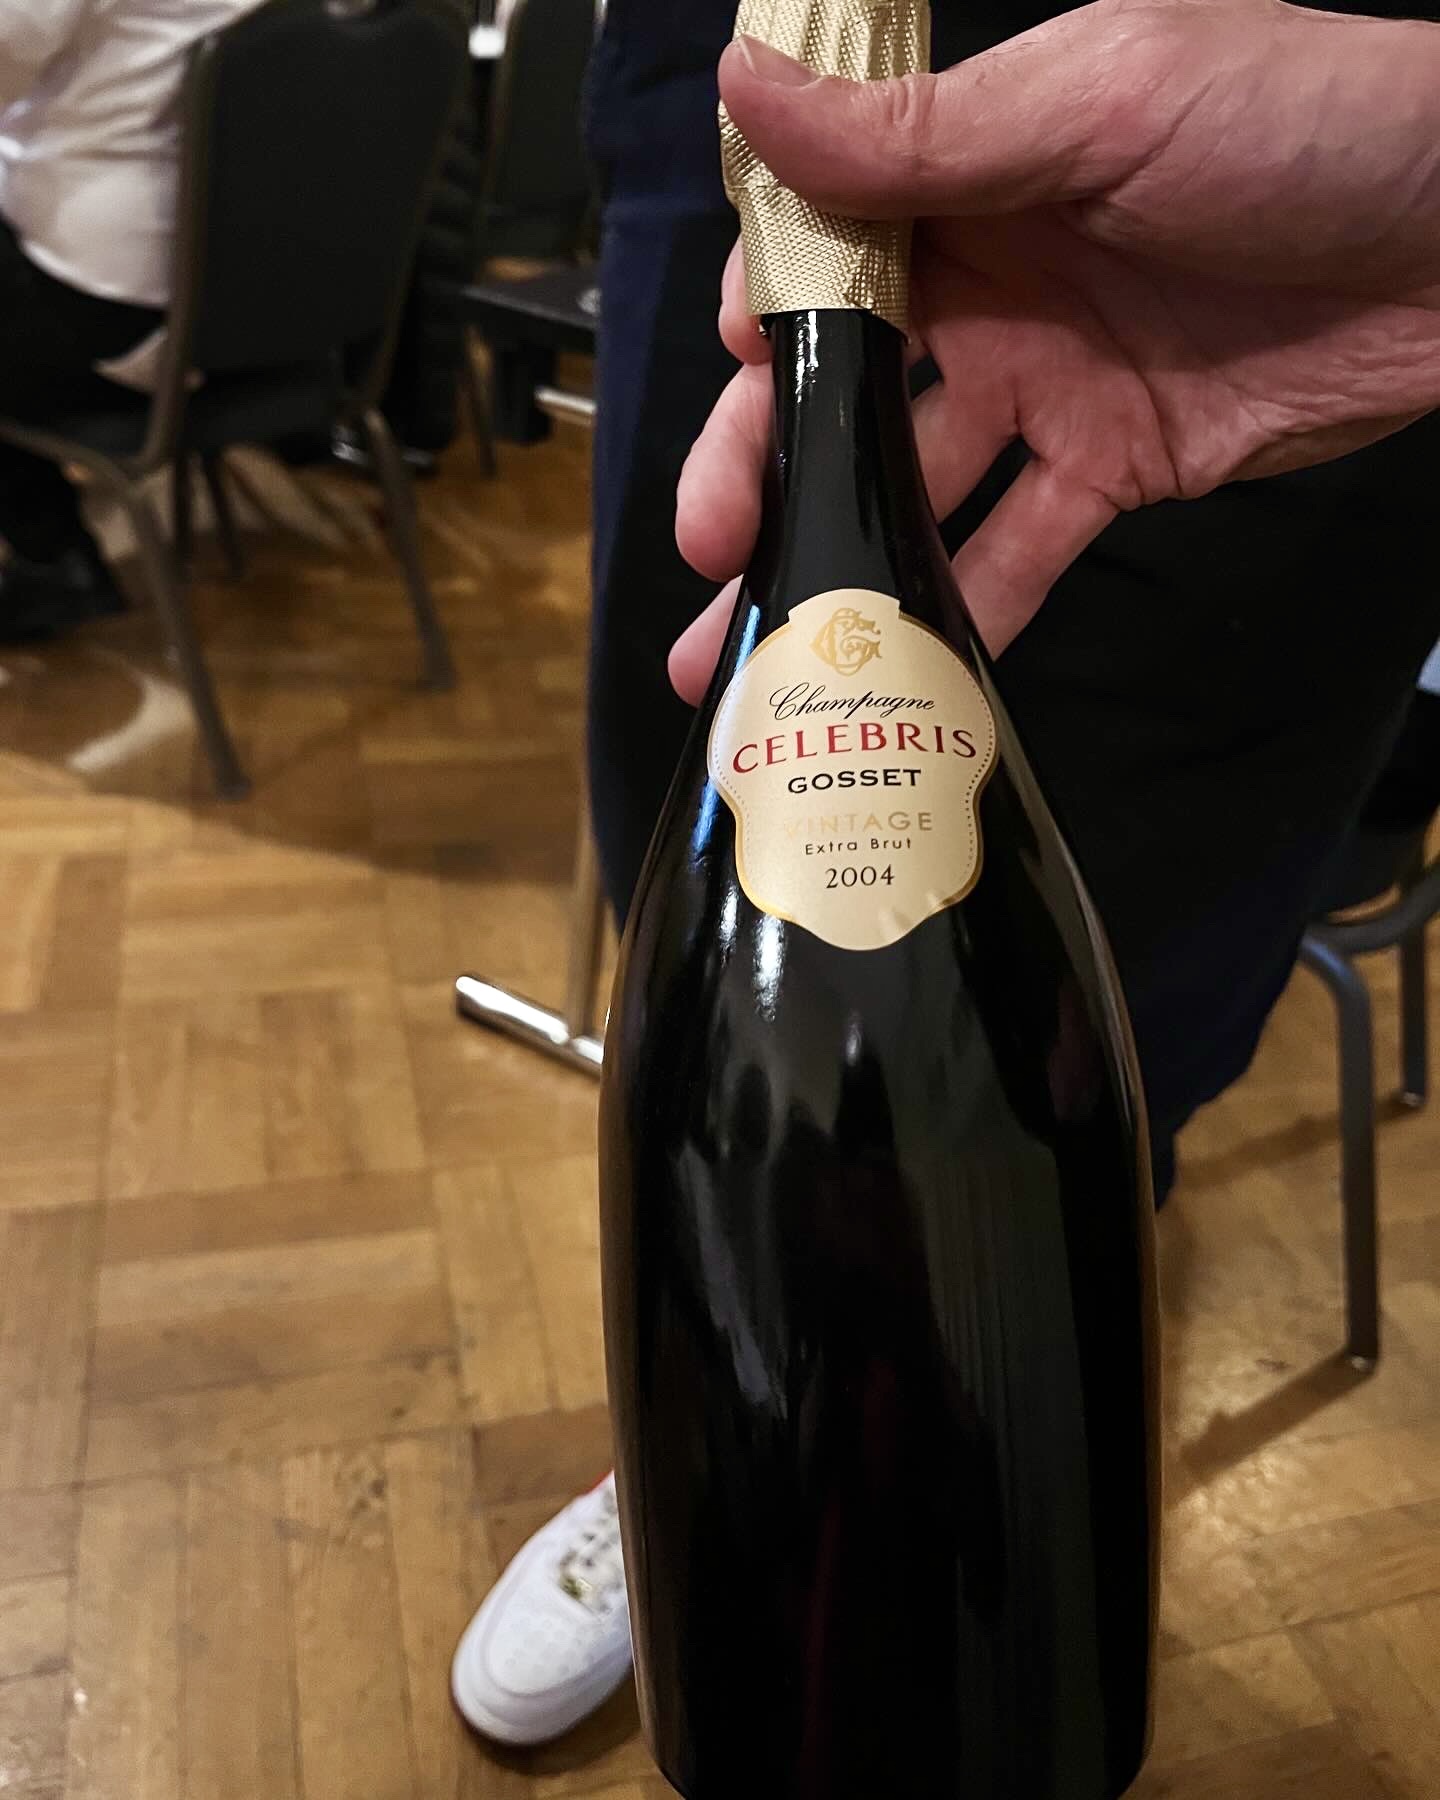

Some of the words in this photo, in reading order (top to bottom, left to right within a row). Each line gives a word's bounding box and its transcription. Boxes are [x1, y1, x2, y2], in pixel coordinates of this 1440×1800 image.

[769, 682, 936, 720] Champagne
[732, 722, 977, 774] CELEBRIS
[787, 768, 922, 794] GOSSET
[784, 811, 933, 838] VINTAGE
[804, 841, 858, 855] Extra
[870, 837, 912, 850] Brut
[825, 864, 895, 889] 2004
